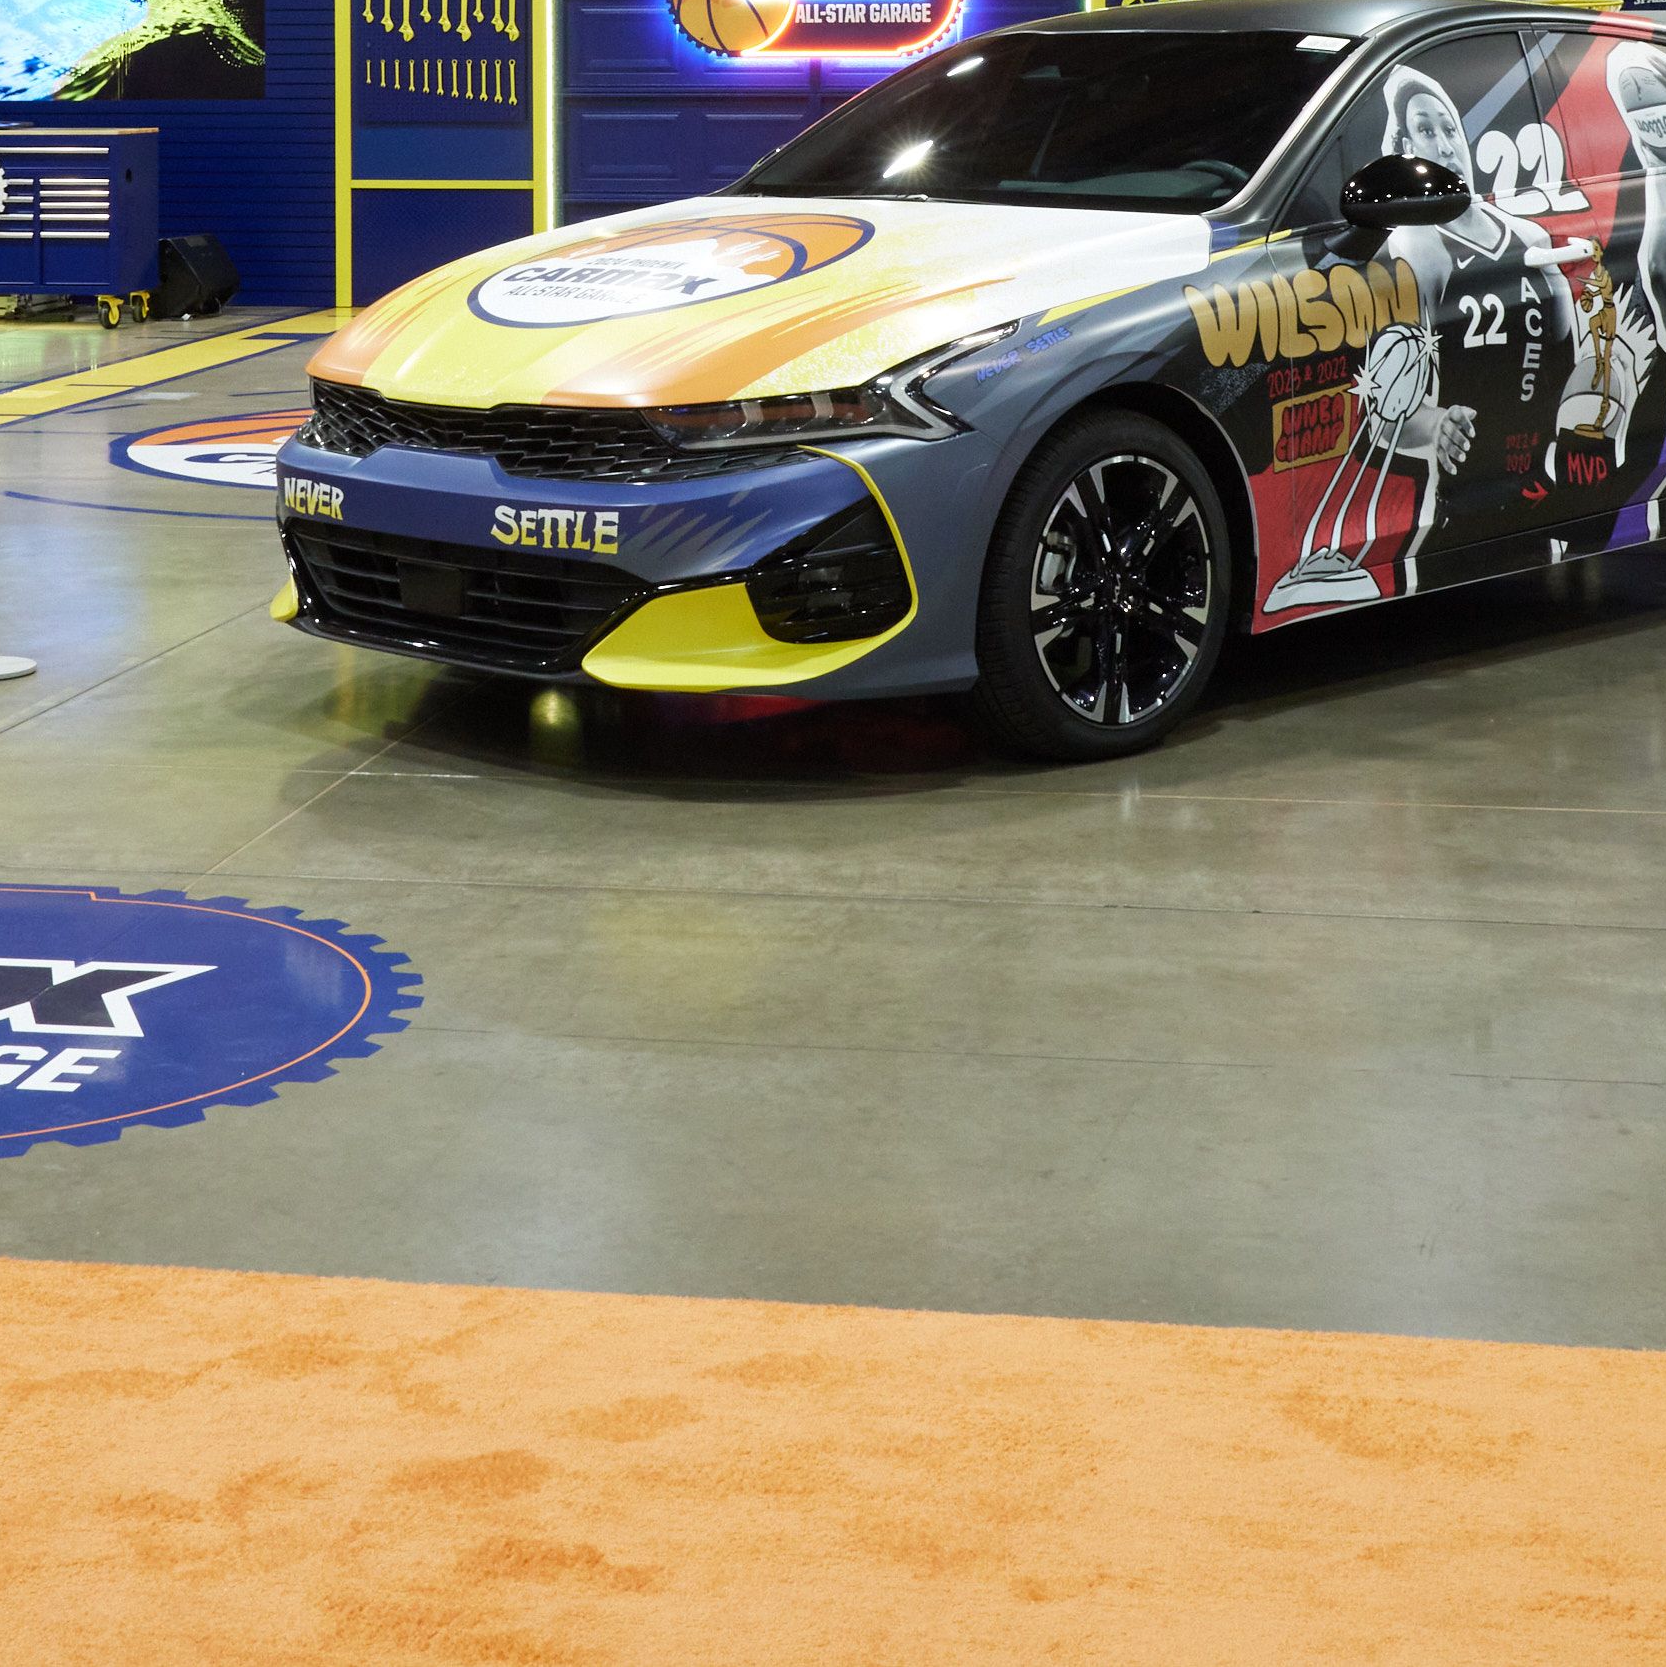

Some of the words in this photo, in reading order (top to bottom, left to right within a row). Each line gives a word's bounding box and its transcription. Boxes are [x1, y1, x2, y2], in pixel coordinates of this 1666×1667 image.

[795, 3, 867, 24] ALL-STAR
[869, 3, 932, 23] GARAGE
[1476, 122, 1592, 216] 22
[1184, 258, 1420, 367] WILSON
[1458, 293, 1508, 348] 22
[1317, 355, 1348, 384] 2022
[1282, 392, 1346, 435] WNBA
[1276, 420, 1344, 462] CHAMP
[284, 477, 345, 521] NEVER
[490, 505, 620, 554] SETTLE
